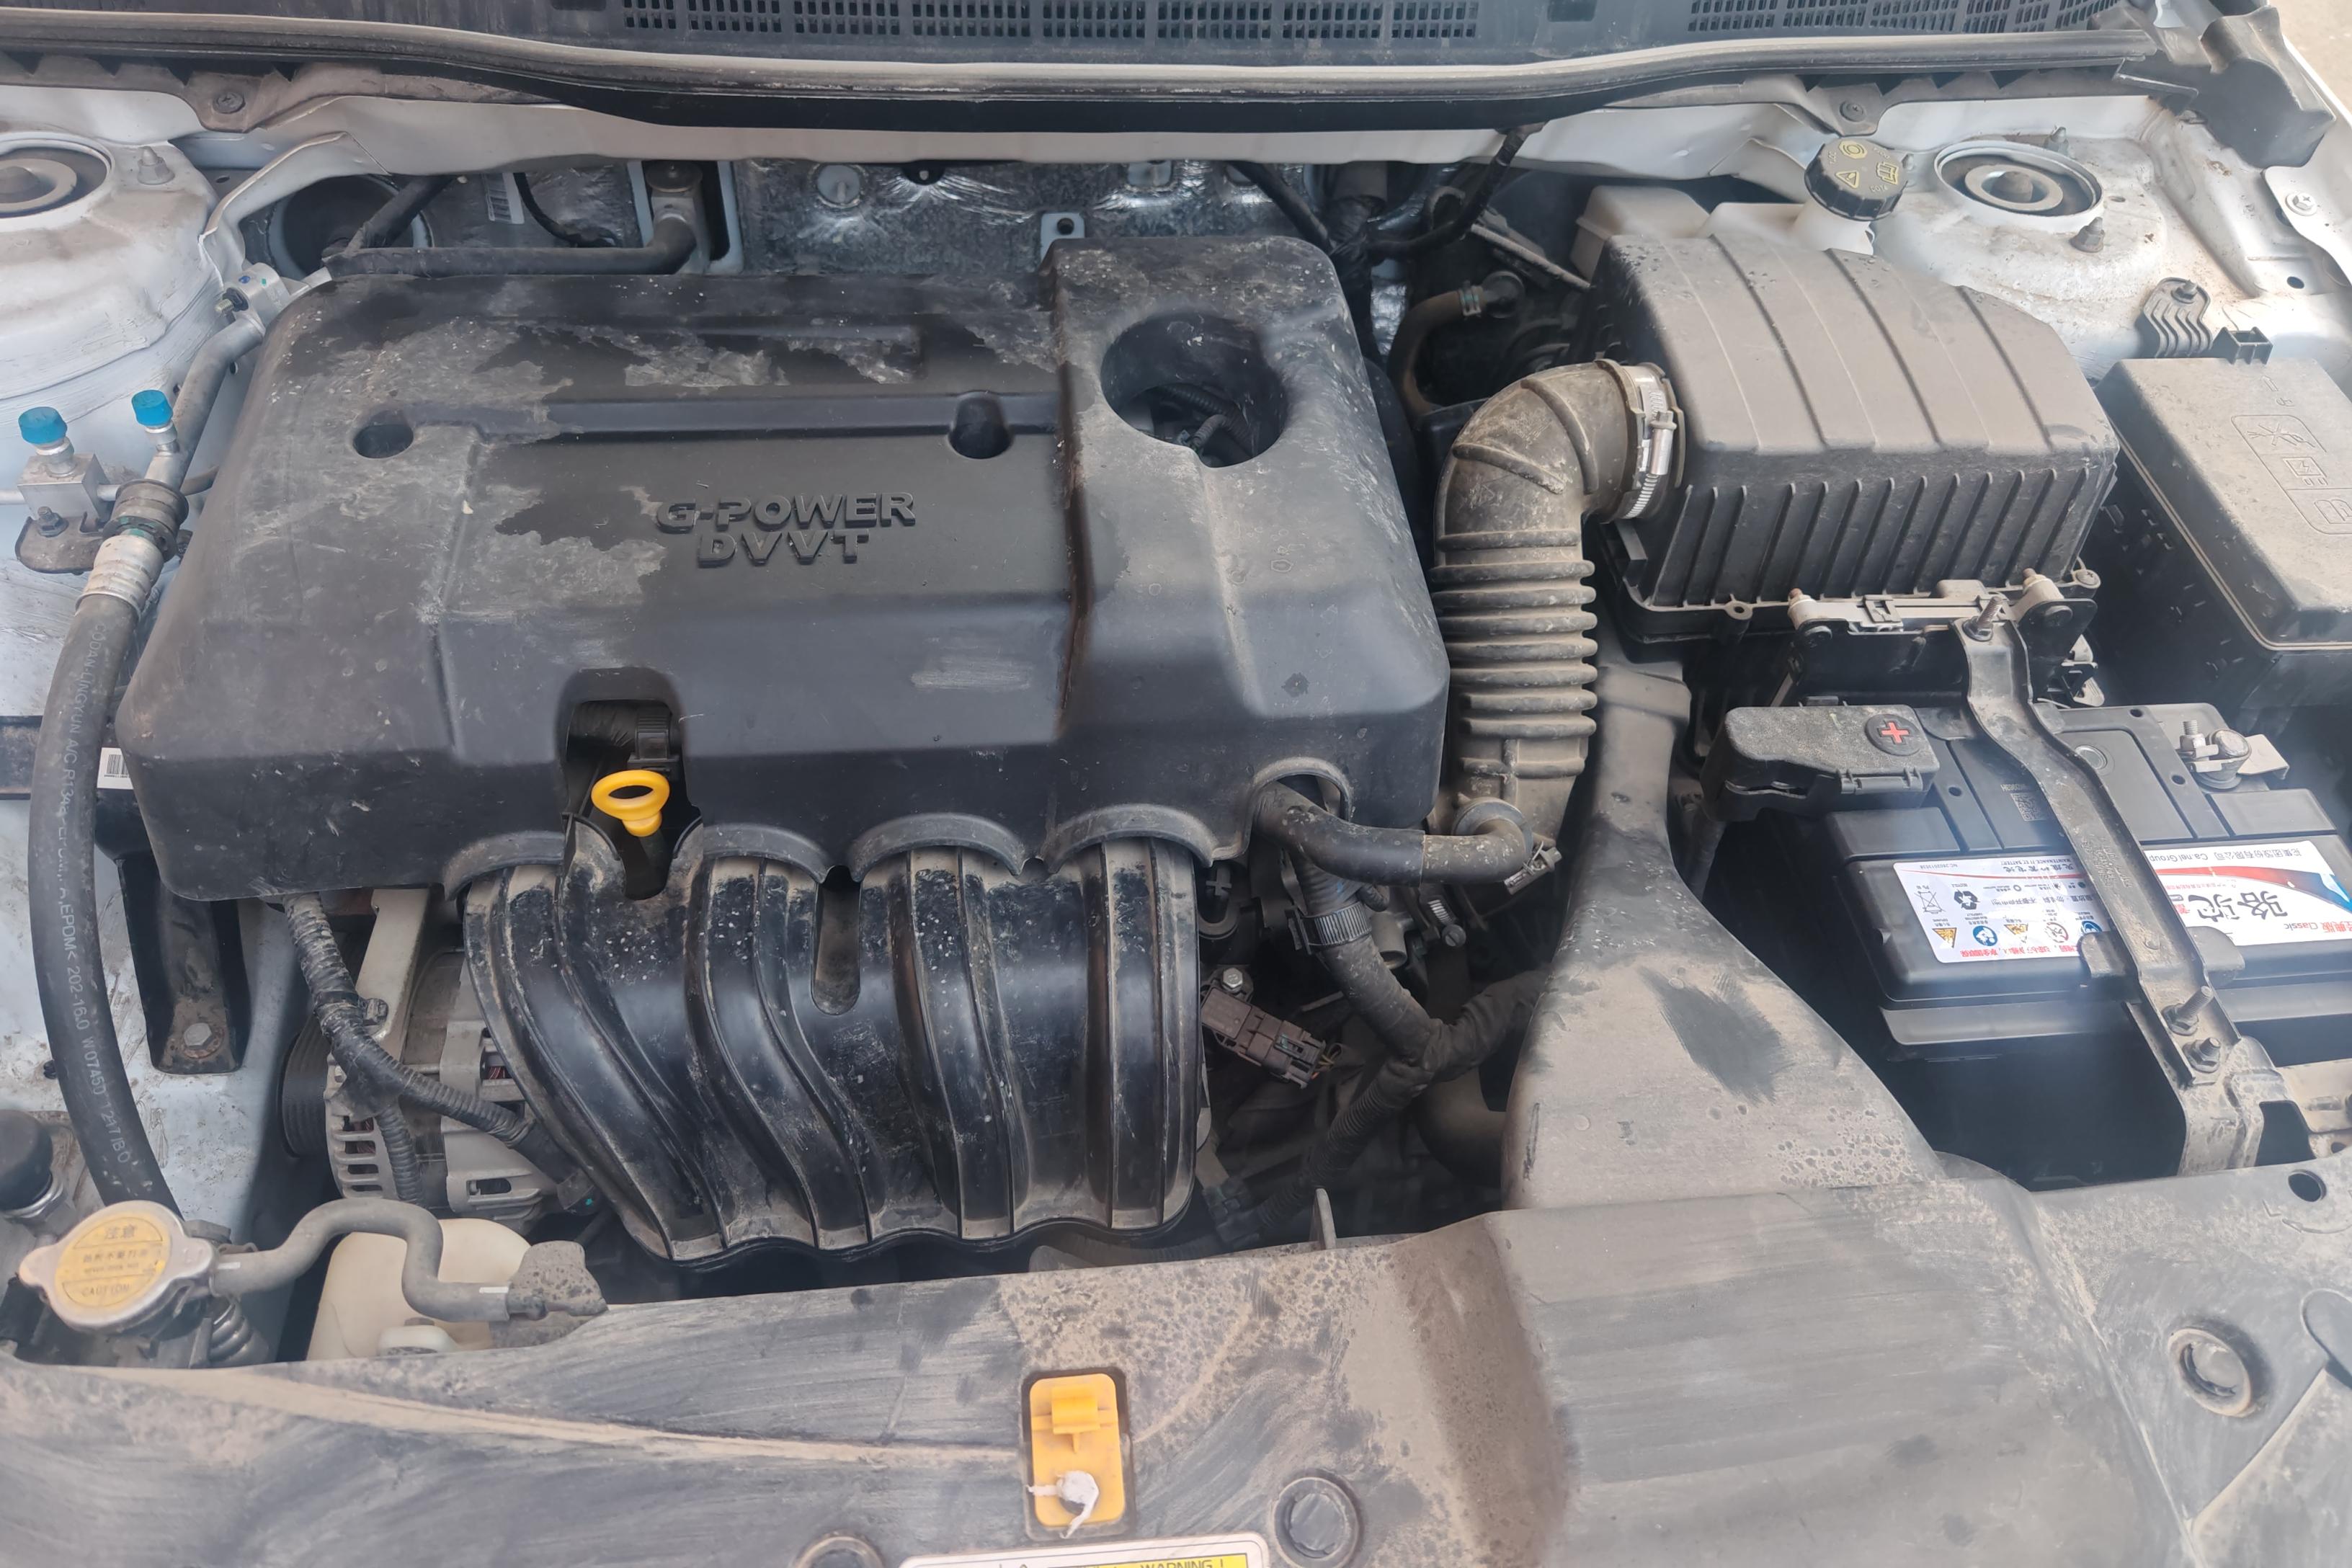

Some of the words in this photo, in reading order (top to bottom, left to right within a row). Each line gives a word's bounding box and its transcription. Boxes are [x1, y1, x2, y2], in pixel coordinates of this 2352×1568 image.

[656, 491, 916, 533] G-POWER
[698, 530, 870, 568] DVVT
[2188, 891, 2289, 922] 骆驼
[81, 1282, 130, 1298] CAUTION
